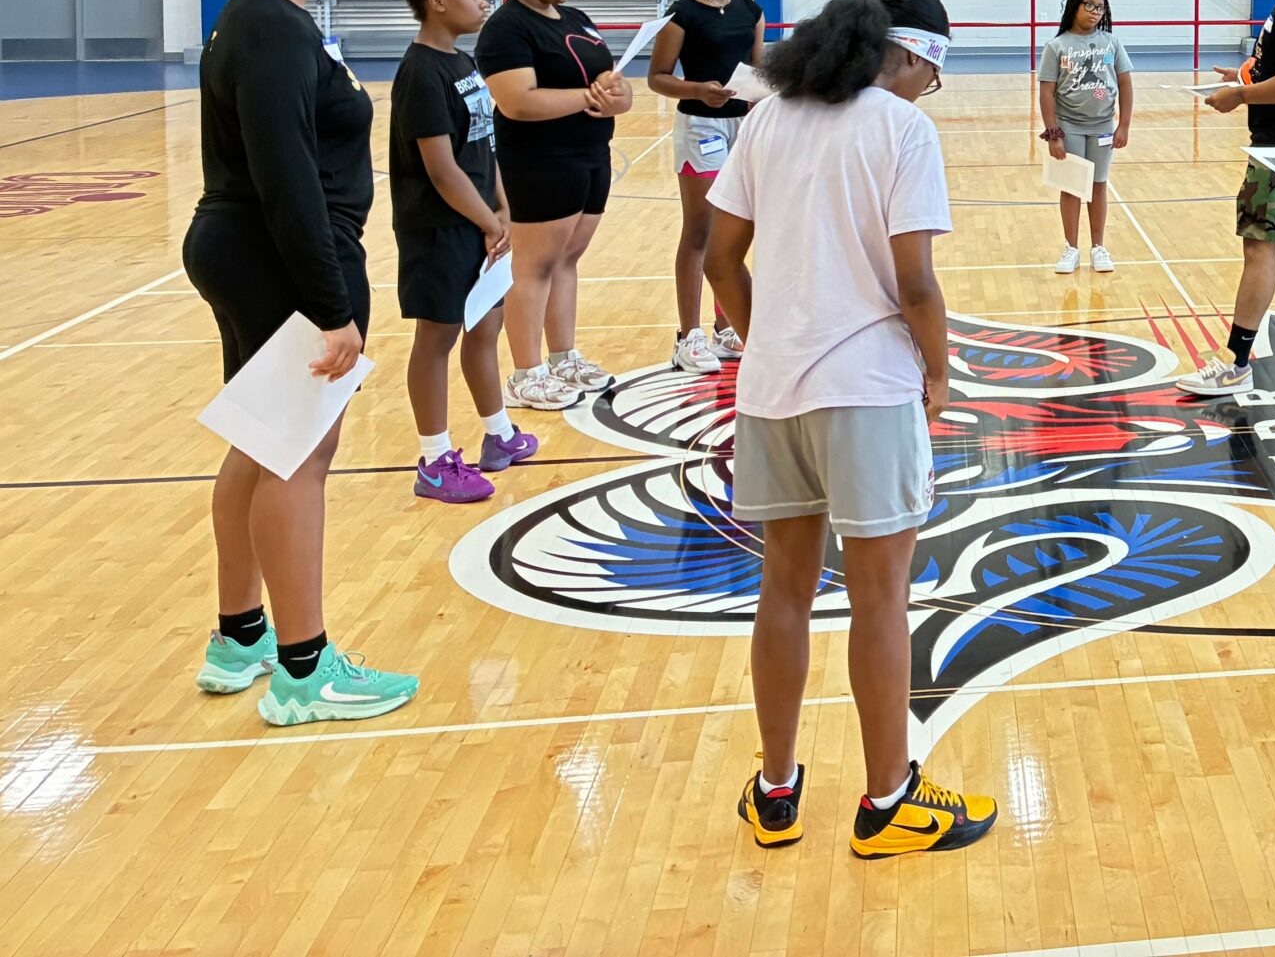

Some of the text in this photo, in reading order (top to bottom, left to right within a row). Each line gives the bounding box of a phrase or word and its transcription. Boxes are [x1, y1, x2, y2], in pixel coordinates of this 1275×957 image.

[1068, 44, 1112, 61] Inspired
[1072, 62, 1088, 80] by
[1091, 59, 1107, 73] the
